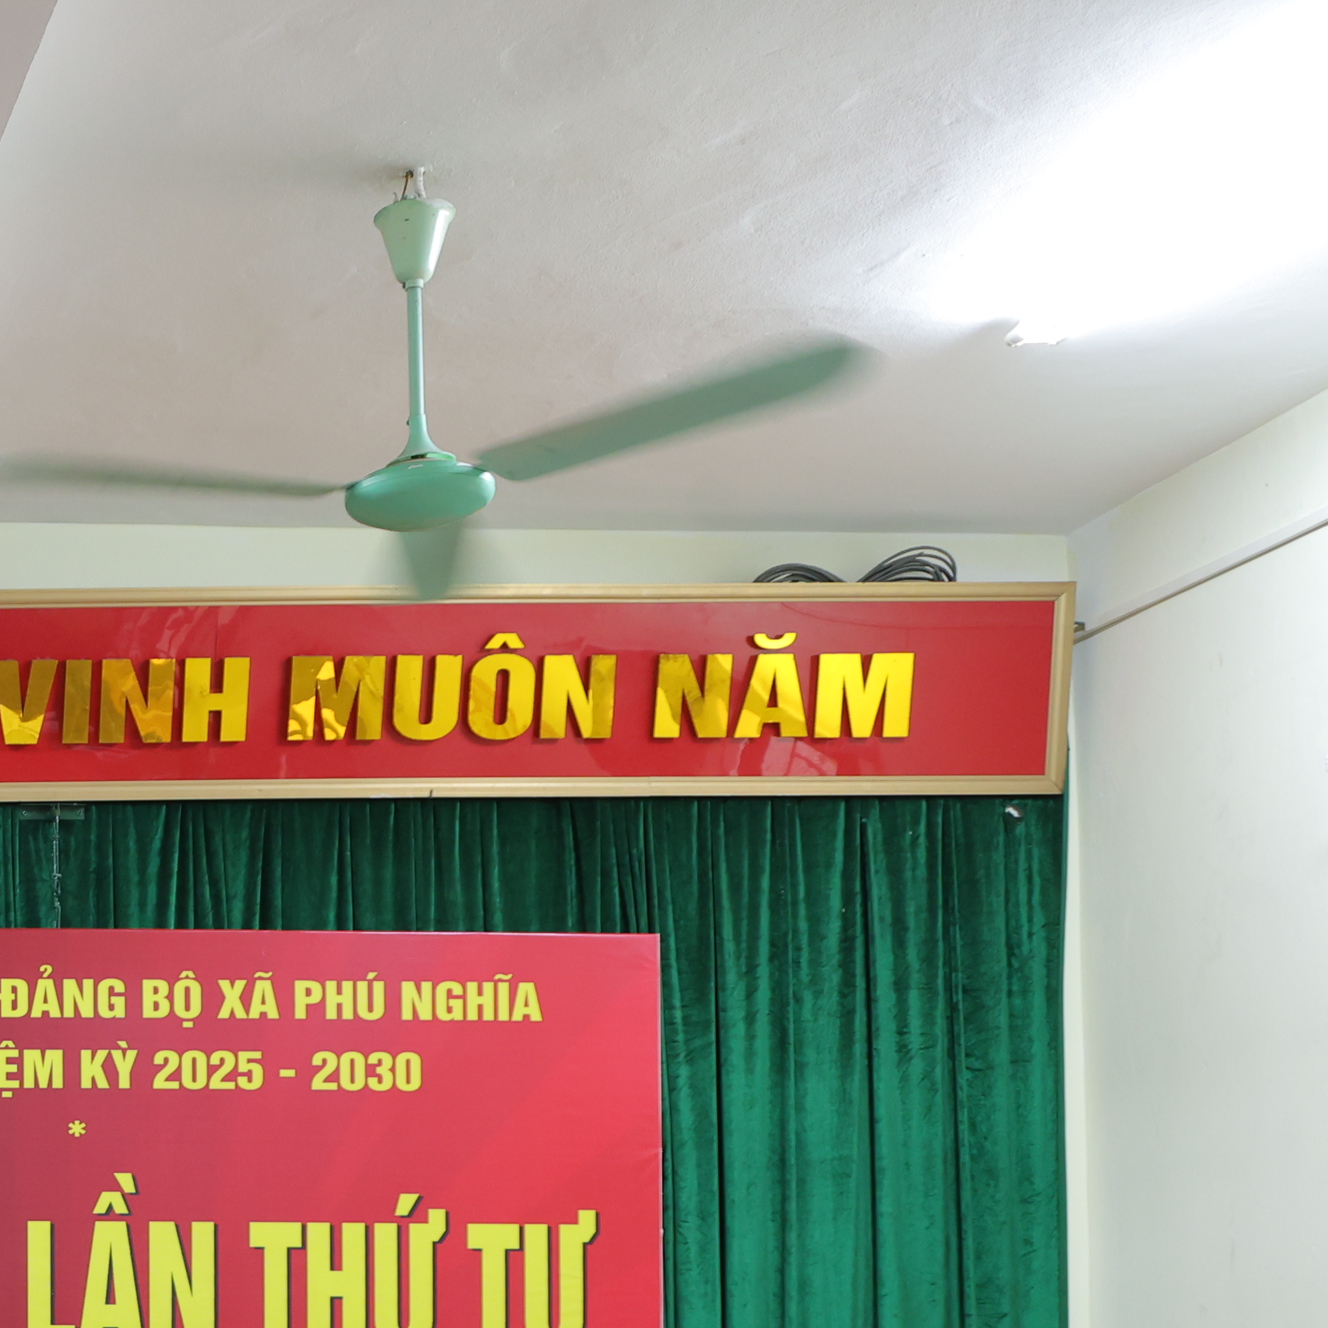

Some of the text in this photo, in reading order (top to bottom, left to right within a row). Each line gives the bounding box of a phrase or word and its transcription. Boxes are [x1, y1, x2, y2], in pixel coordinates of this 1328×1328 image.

[286, 632, 618, 741] MUÔN
[652, 631, 916, 739] NĂM
[142, 970, 203, 1028] BỘ
[218, 971, 280, 1019] XÃ
[294, 972, 386, 1021] PHÚ
[401, 973, 543, 1022] NGHĨA
[80, 1040, 139, 1089] KỲ
[152, 1049, 264, 1090] 2025
[279, 1069, 297, 1078] -
[311, 1051, 422, 1092] 2030
